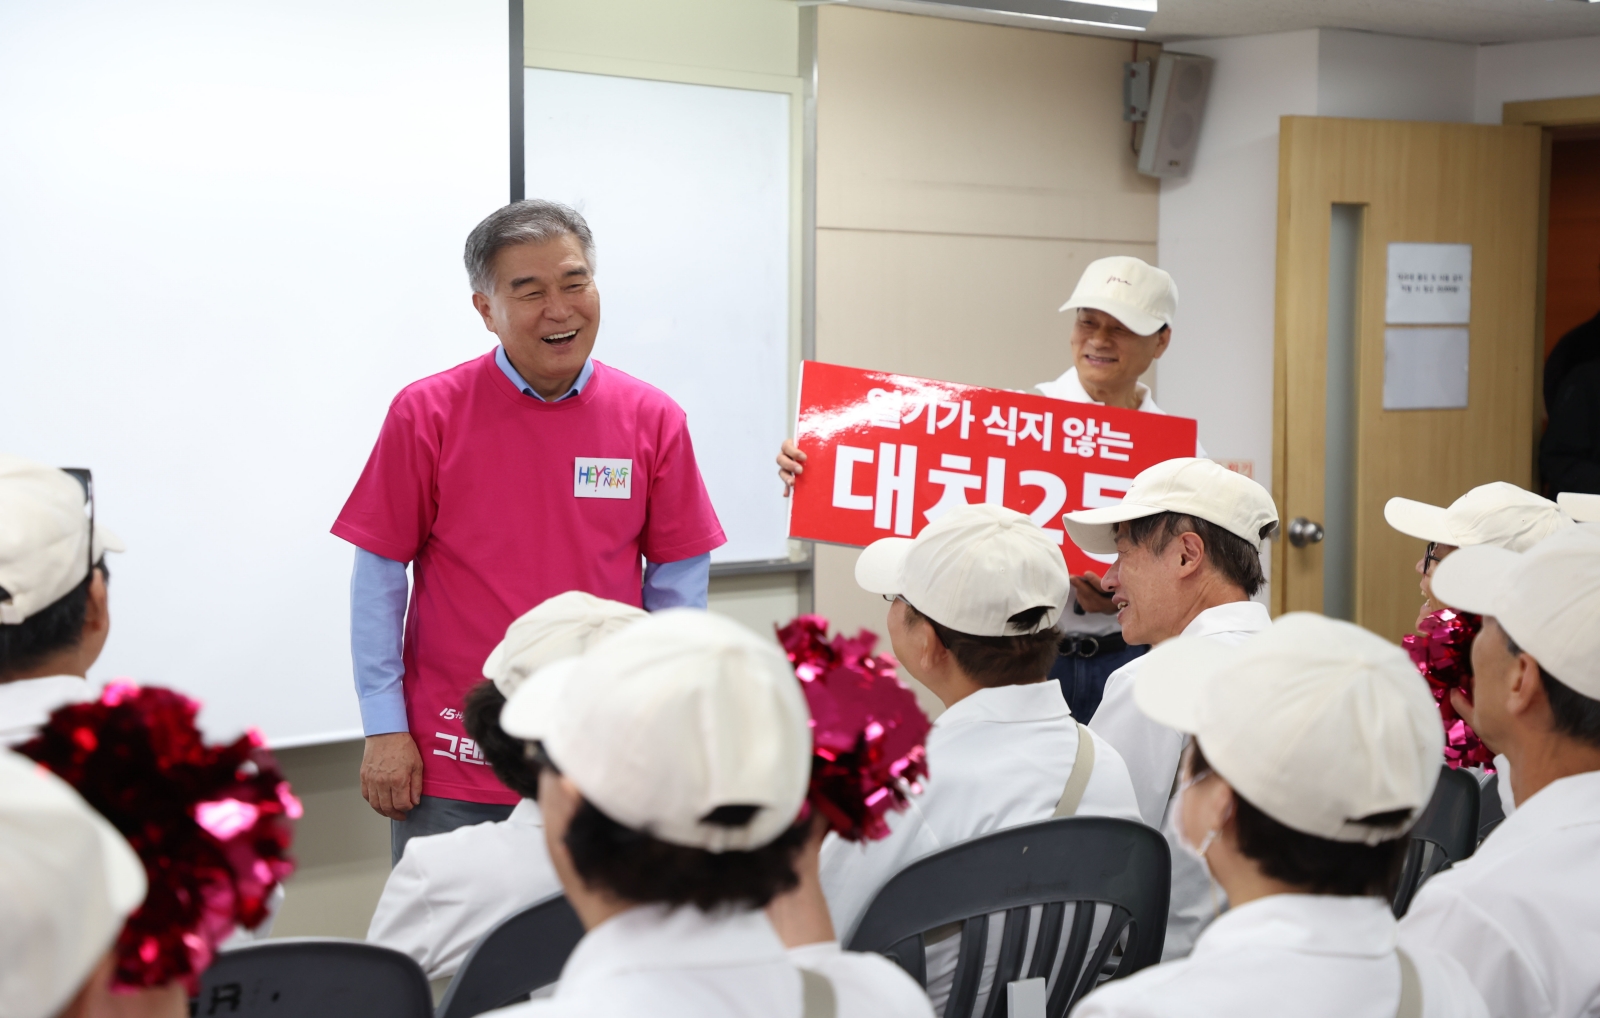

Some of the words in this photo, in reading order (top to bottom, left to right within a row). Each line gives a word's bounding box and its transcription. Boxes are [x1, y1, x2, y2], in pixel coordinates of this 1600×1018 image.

[867, 388, 976, 440] 열기가
[981, 405, 1054, 452] 식지
[1062, 416, 1134, 462] 않는
[603, 476, 626, 488] NAM
[433, 731, 492, 766] 그랜
